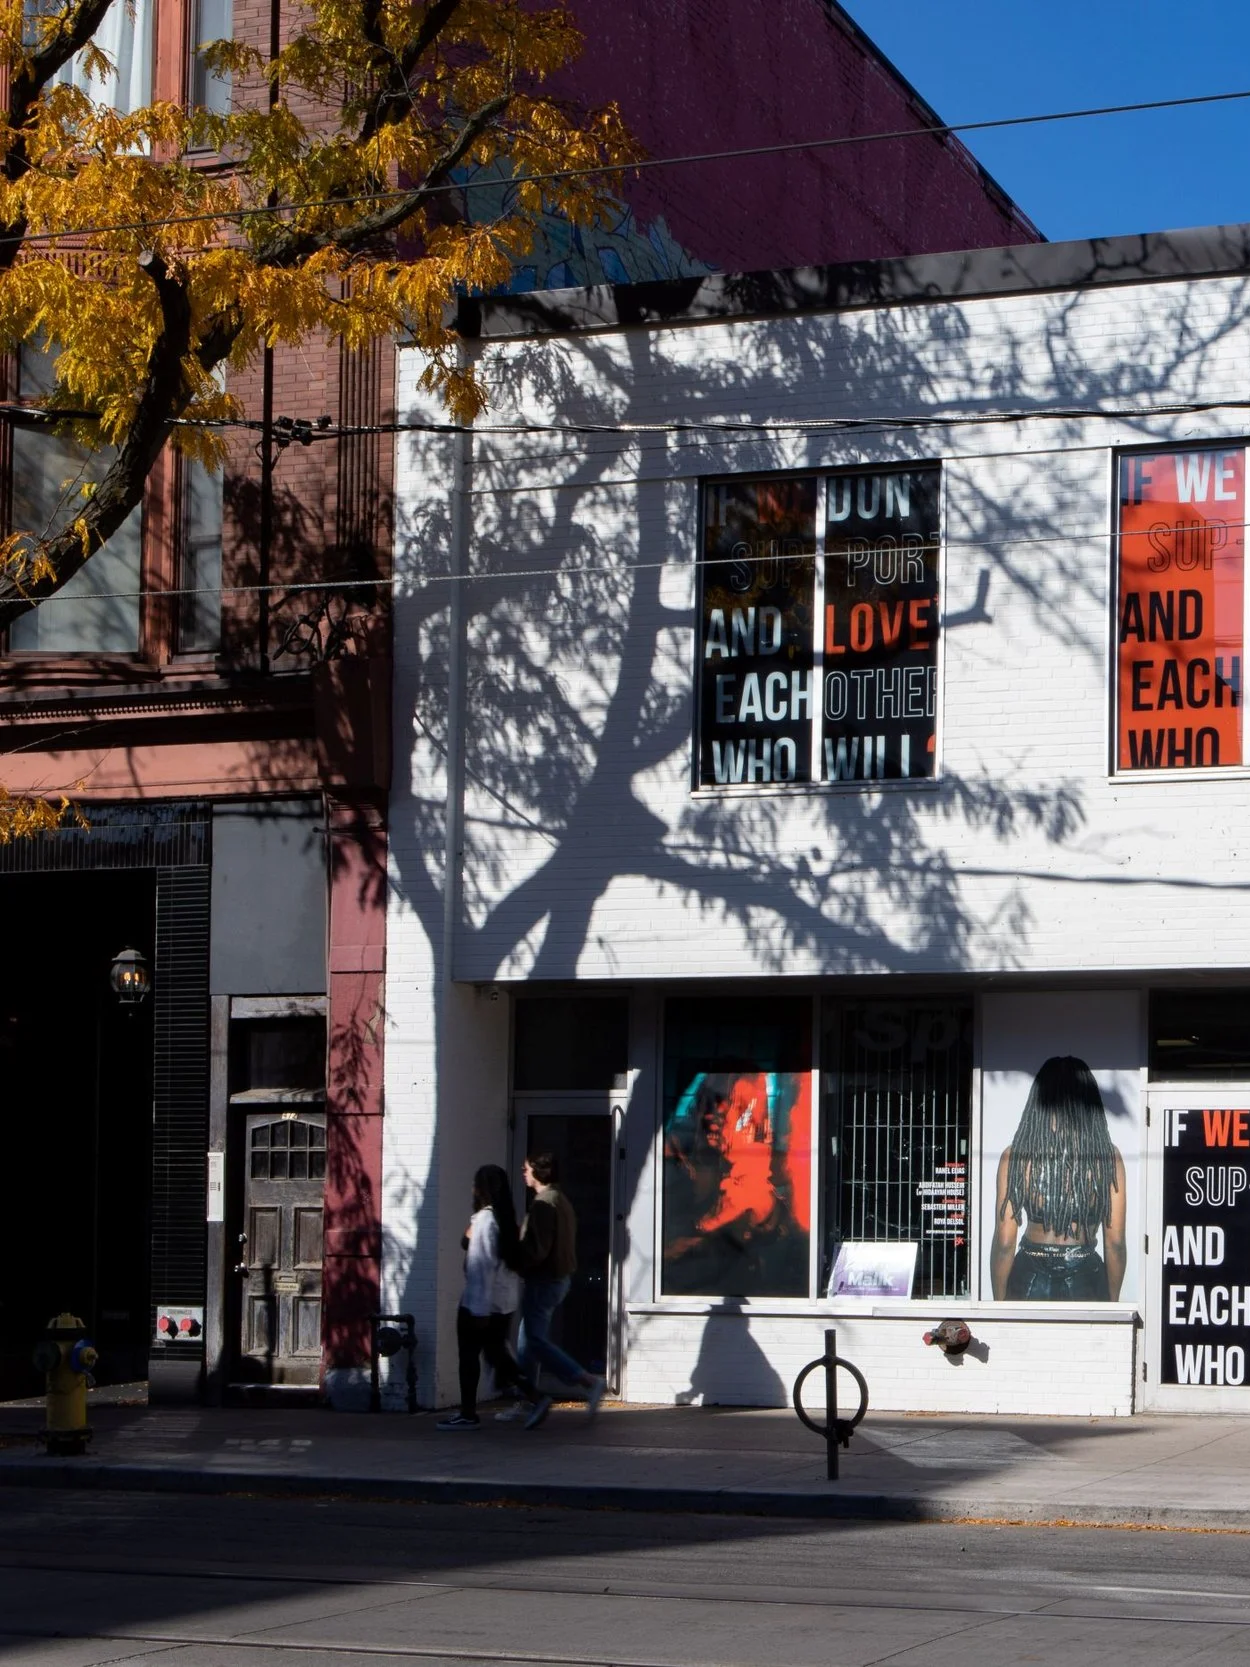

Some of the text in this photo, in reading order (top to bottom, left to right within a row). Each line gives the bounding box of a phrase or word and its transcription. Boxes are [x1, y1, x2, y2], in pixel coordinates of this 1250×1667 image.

[1121, 457, 1157, 507] IF
[1175, 452, 1238, 503] WE
[730, 538, 806, 591] SUP
[1147, 518, 1244, 573] SUP-
[705, 605, 782, 659] AND
[1120, 588, 1204, 643] AND
[715, 670, 813, 724] EACH
[1132, 655, 1240, 712] EACH
[712, 737, 797, 784] WHO
[1128, 726, 1220, 768] WHO
[1164, 1110, 1188, 1147] IF
[1203, 1110, 1250, 1147] WE
[1163, 1226, 1224, 1266] AND
[1169, 1285, 1250, 1326] EACH
[1175, 1344, 1245, 1385] WHO
